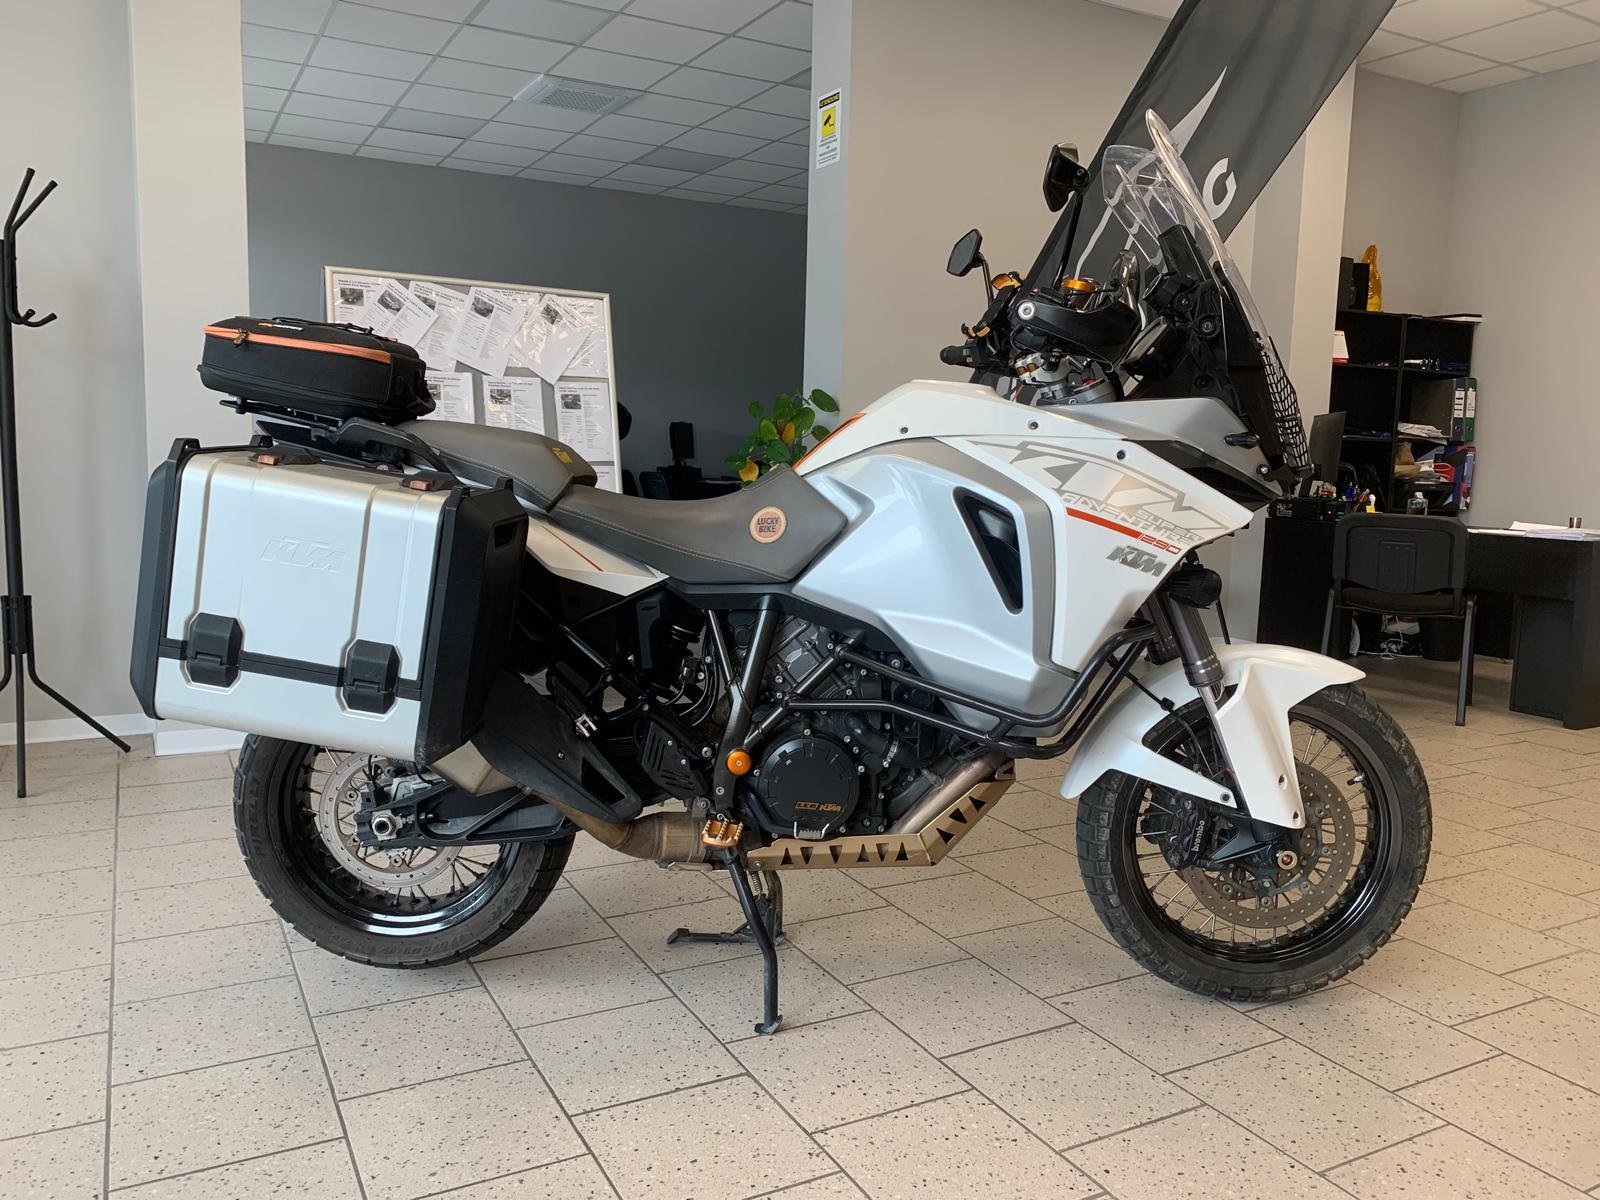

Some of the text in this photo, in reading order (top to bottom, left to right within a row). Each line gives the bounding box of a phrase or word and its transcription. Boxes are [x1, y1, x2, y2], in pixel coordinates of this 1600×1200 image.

[757, 517, 779, 525] LUCKY
[759, 525, 776, 533] BIKE
[1136, 508, 1206, 543] SUPER
[1106, 545, 1168, 578] KTM
[1191, 821, 1206, 851] brembo
